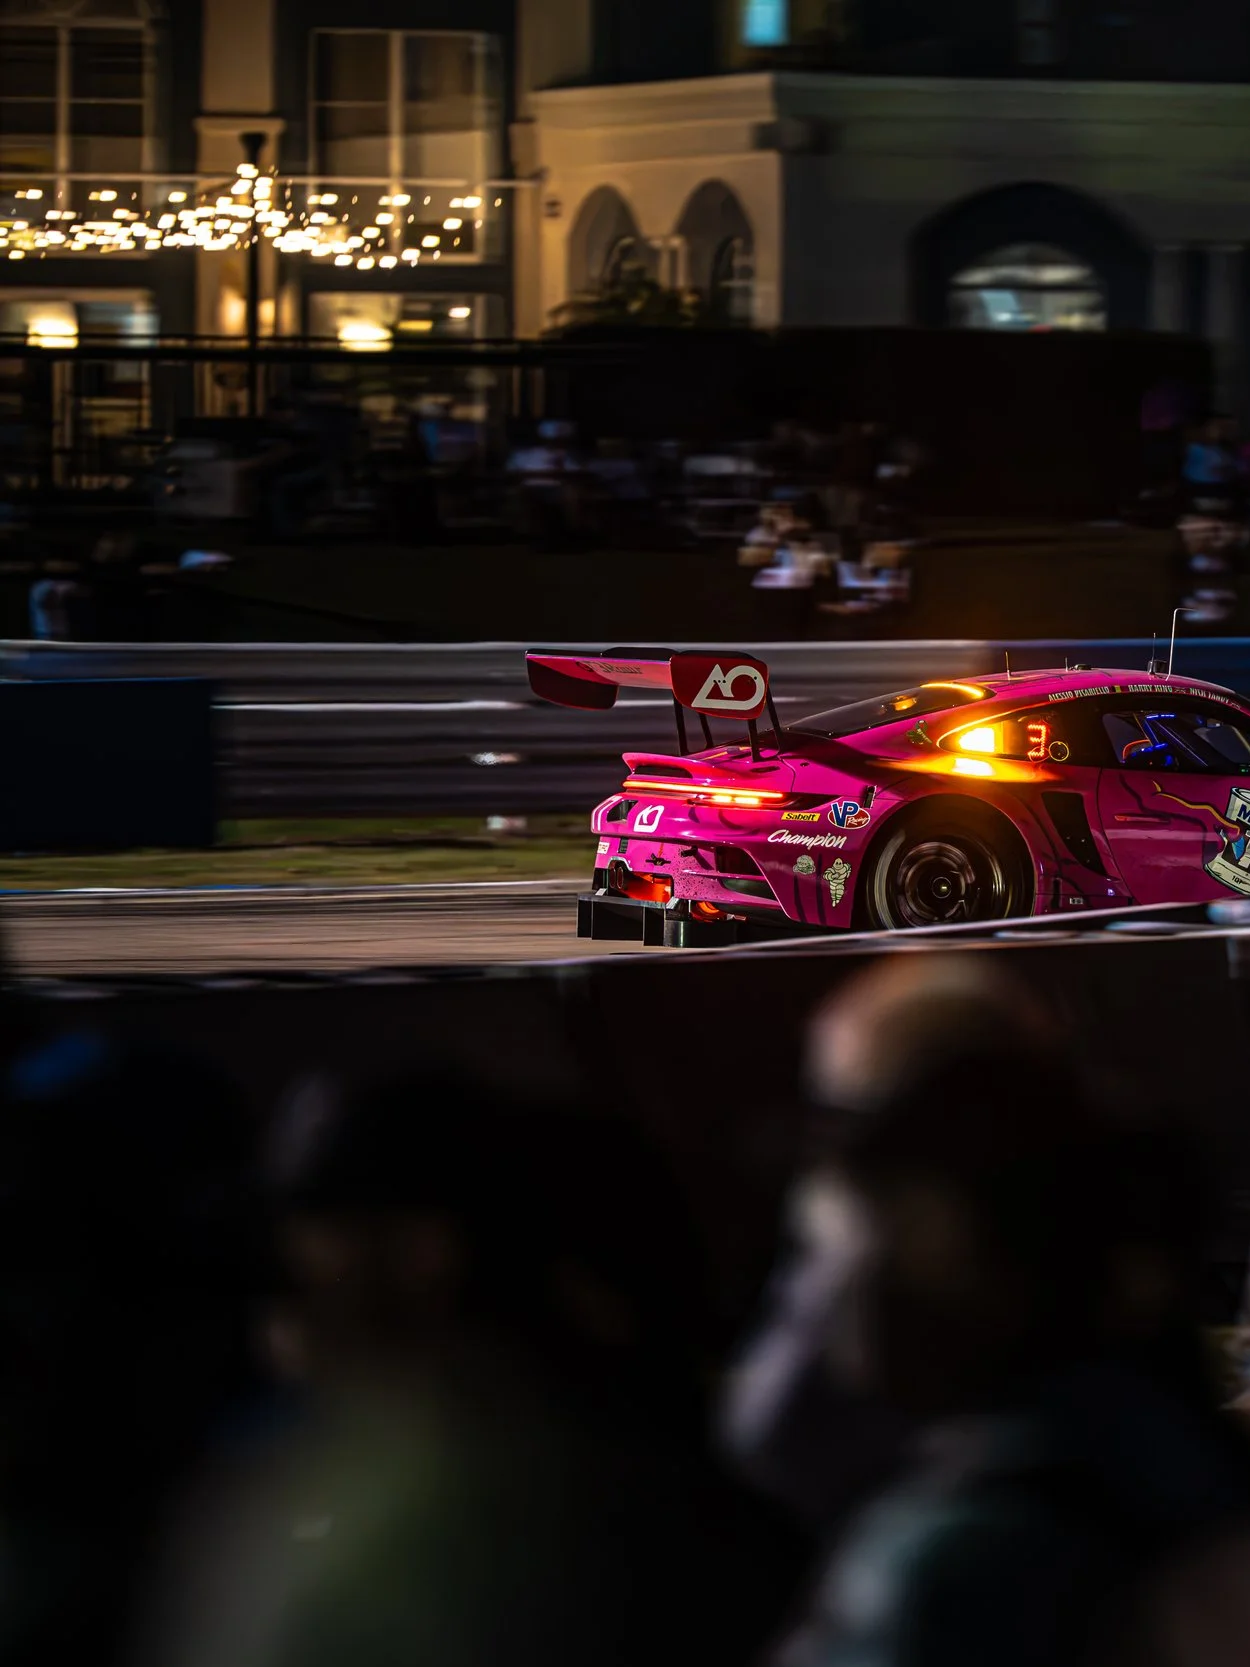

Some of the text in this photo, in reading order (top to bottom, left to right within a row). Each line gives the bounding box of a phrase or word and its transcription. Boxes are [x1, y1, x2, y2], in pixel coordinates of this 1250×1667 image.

[1048, 690, 1073, 701] ALESSIO
[1128, 684, 1173, 693] HARRY KING
[1028, 724, 1046, 757] 3
[785, 812, 816, 822] Sabelt
[831, 801, 860, 828] VP
[768, 829, 847, 850] Champion
